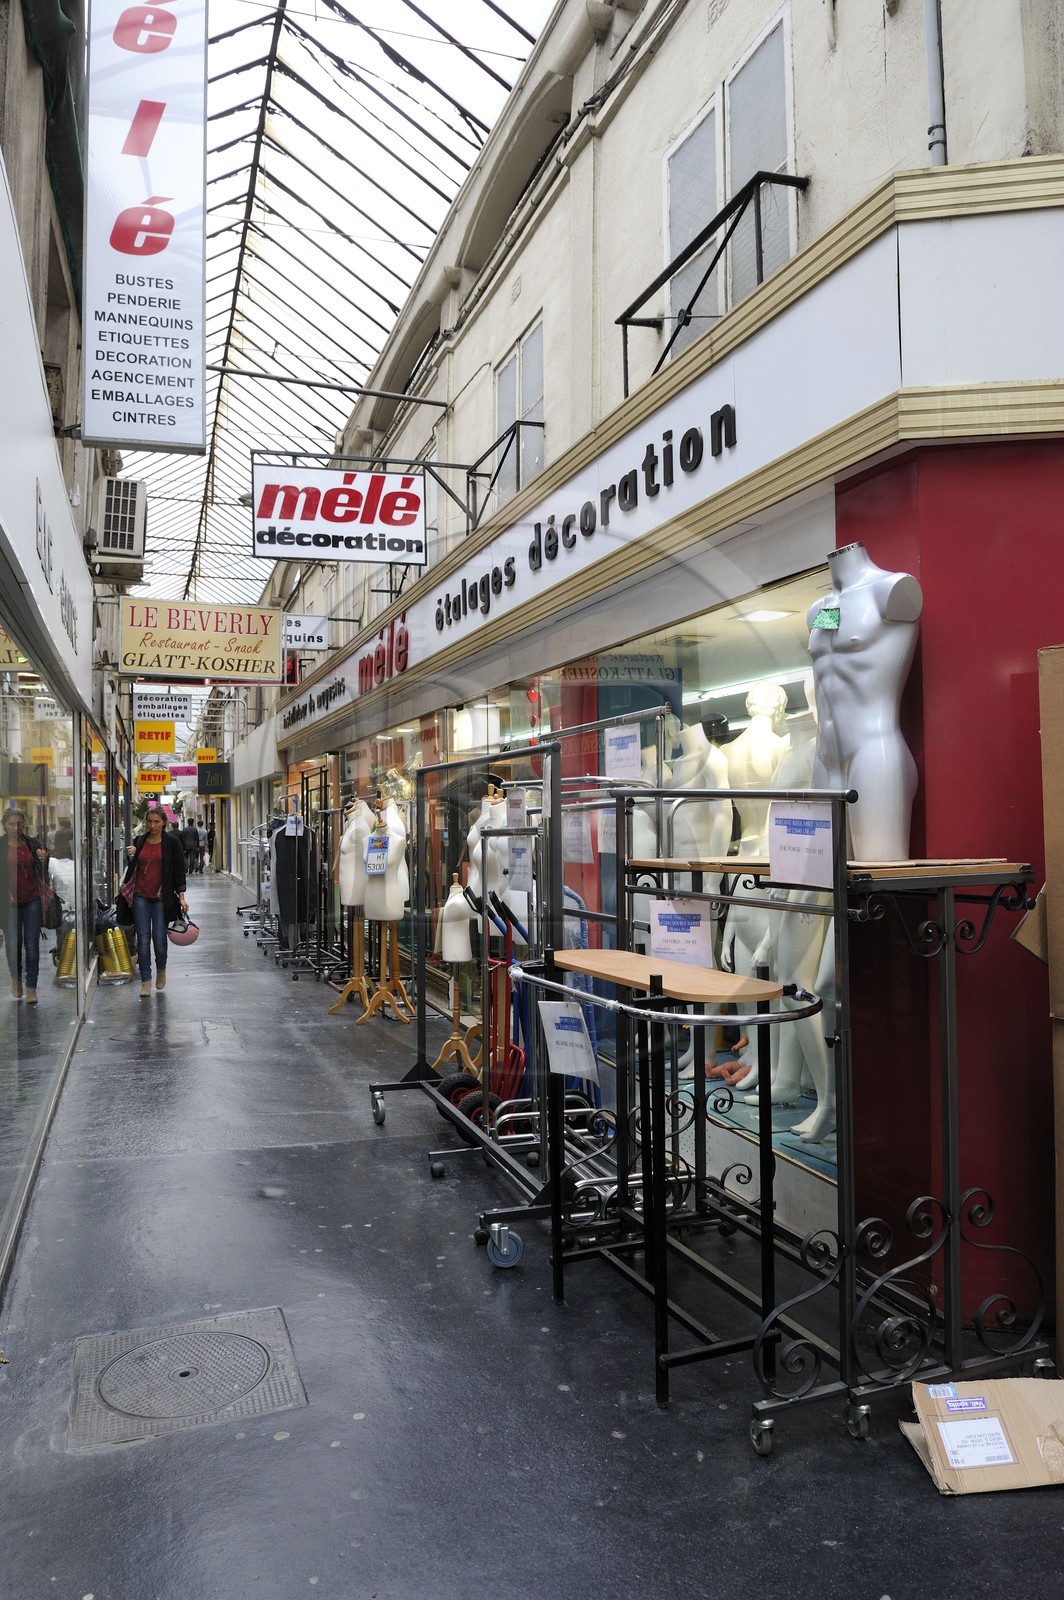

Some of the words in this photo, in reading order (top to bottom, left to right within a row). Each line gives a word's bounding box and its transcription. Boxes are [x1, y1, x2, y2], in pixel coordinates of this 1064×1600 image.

[115, 274, 174, 290] BUSTES
[107, 292, 181, 310] PENDERIE
[94, 310, 193, 331] MANNEQUINS
[98, 330, 189, 350] ETIQUETTES
[95, 349, 192, 369] DECORATION
[91, 369, 195, 389] AGENCEMENT
[91, 389, 194, 408] EMBALLAGES
[112, 411, 176, 426] CINTRES
[256, 473, 421, 527] mélé
[435, 556, 515, 632] étalages
[529, 403, 737, 571] décoration
[256, 526, 423, 553] décoration
[129, 605, 158, 629] LE
[166, 607, 274, 636] BEVERLY
[139, 631, 210, 651] Restaurant
[224, 637, 263, 655] Snack
[122, 652, 276, 675] GLATT-KOSHER
[358, 611, 409, 696] mélé
[137, 695, 188, 703] décoration
[137, 703, 188, 711] emballages
[137, 711, 185, 719] étiquettes
[138, 731, 171, 741] RETIF
[140, 773, 167, 782] RETIF
